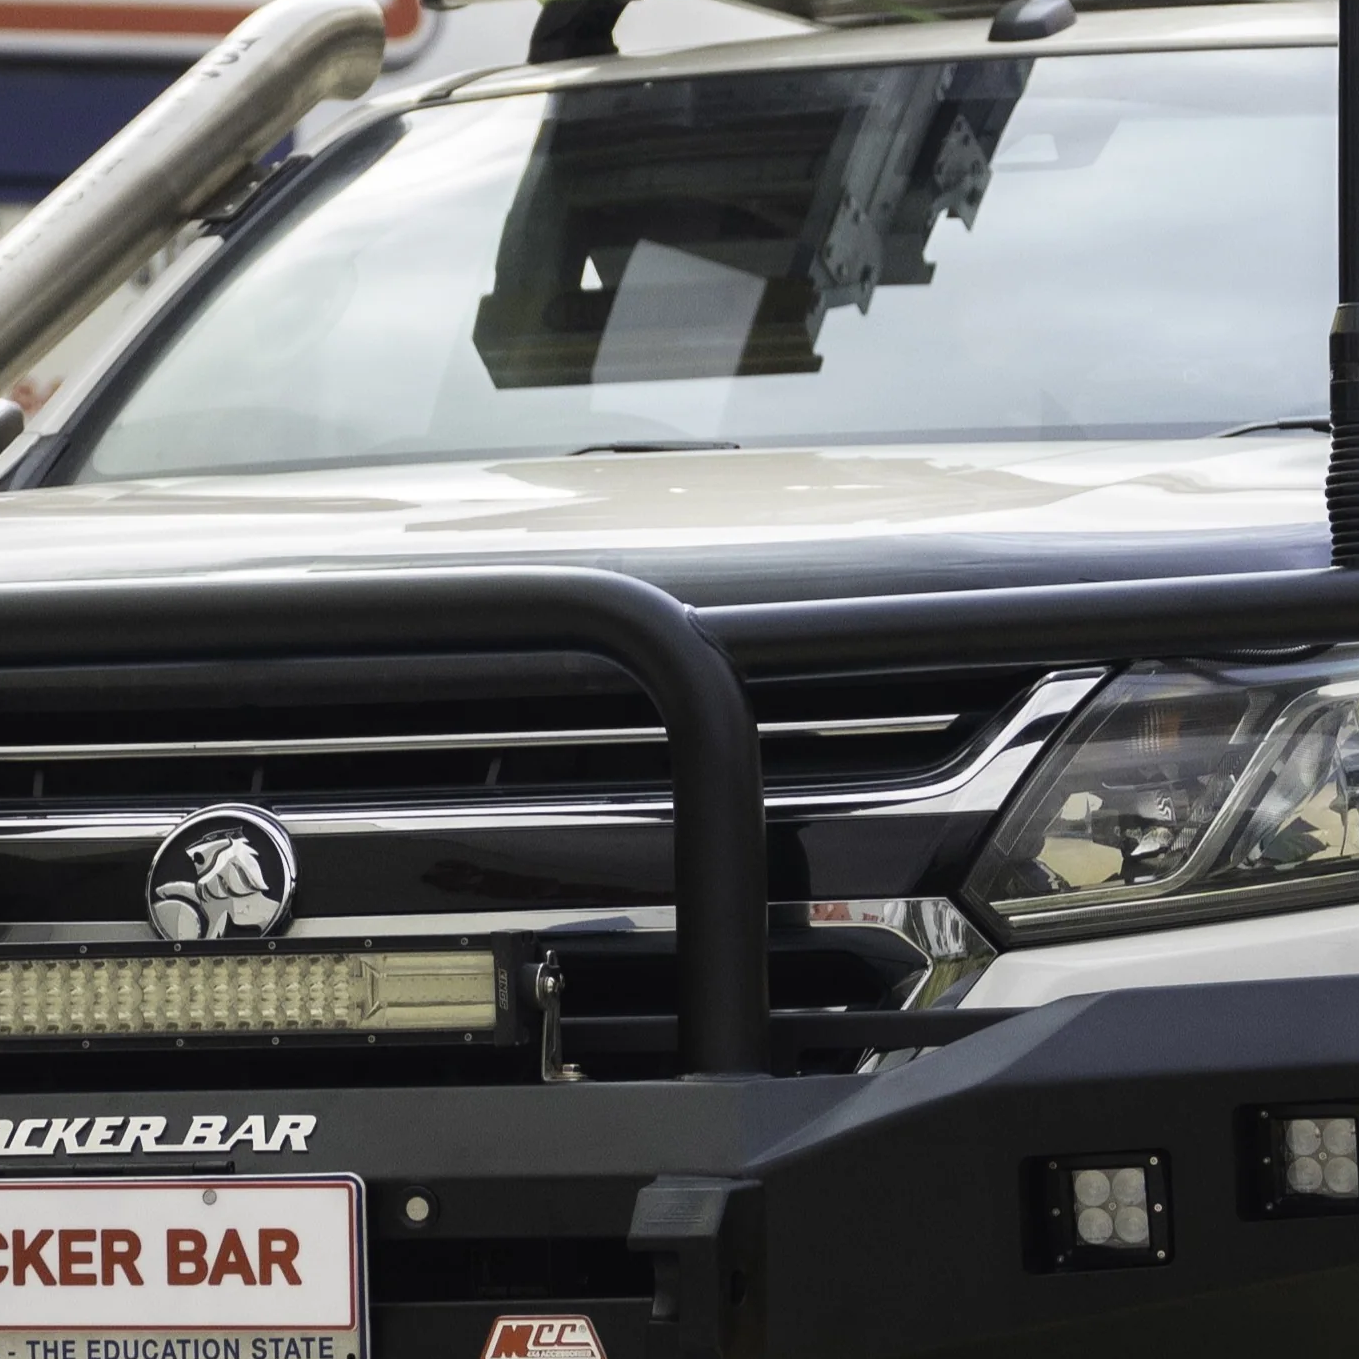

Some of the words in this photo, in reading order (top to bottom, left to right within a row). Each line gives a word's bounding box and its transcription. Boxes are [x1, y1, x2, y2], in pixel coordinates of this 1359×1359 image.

[498, 968, 509, 1011] KINGS
[182, 1114, 318, 1152] BAR
[167, 1228, 302, 1285] BAR
[251, 1336, 334, 1359] STATE
[491, 1324, 592, 1358] MCC
